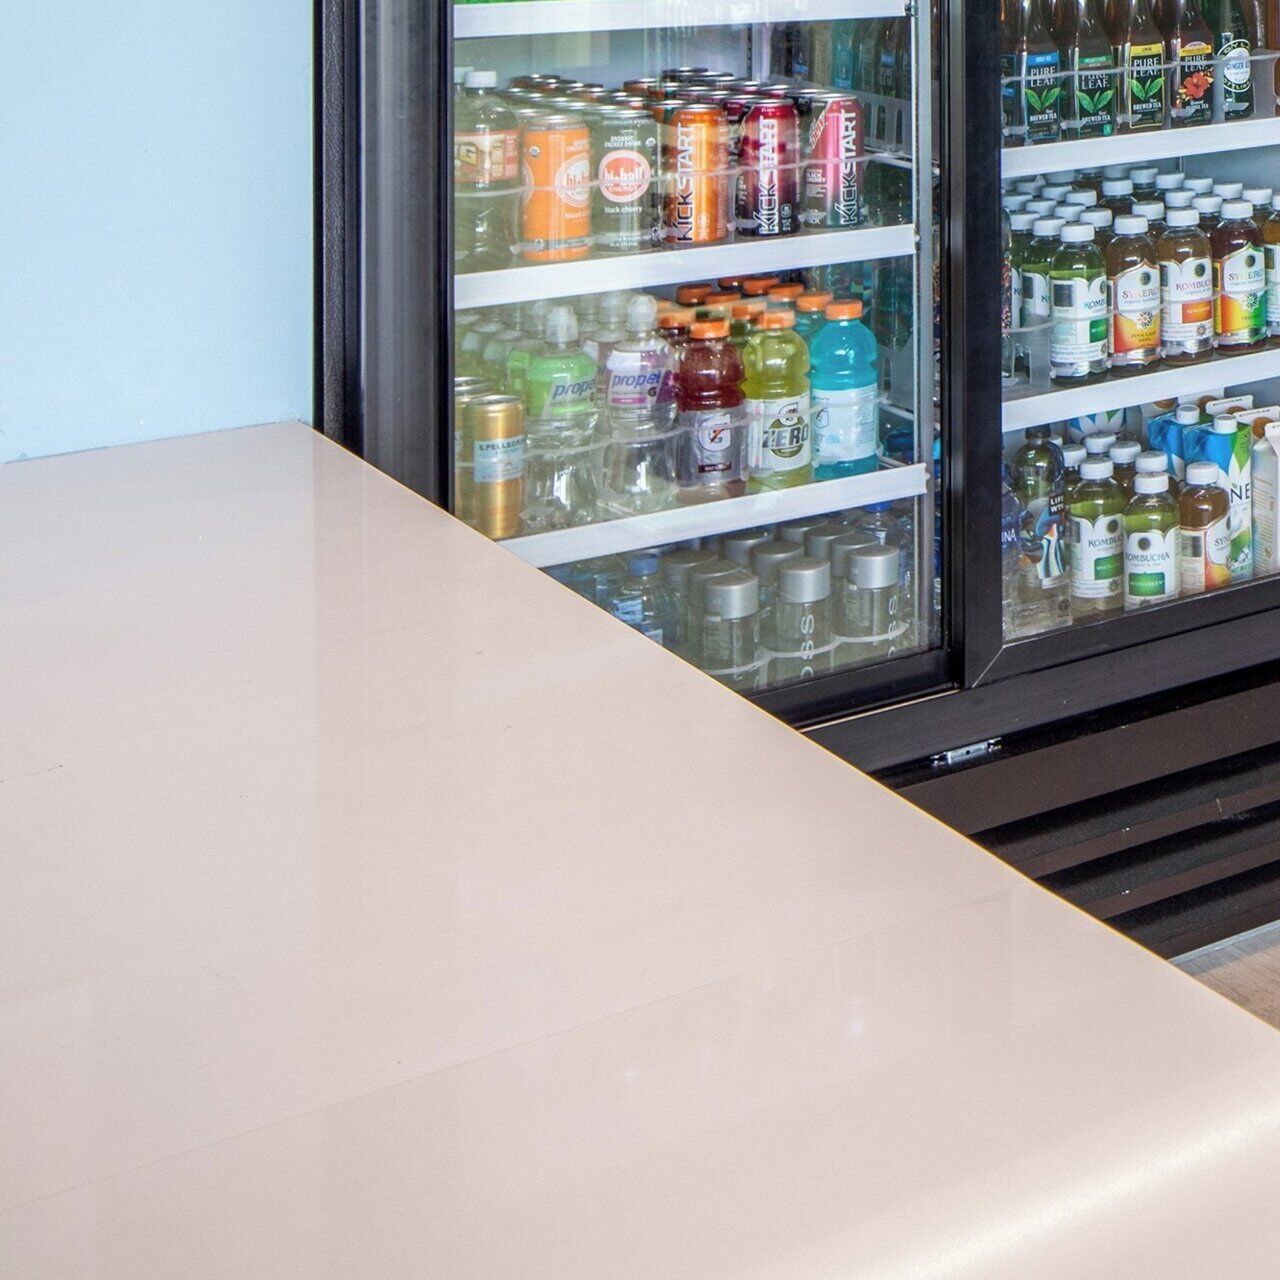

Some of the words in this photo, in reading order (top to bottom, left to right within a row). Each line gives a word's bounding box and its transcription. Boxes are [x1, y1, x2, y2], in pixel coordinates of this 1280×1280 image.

[1134, 57, 1159, 67] PURE
[1184, 55, 1206, 63] PURE
[1134, 69, 1160, 78] LEAF
[1030, 77, 1056, 88] LEAF
[1081, 79, 1110, 90] LEAF
[835, 109, 856, 225] KICKSTART
[753, 116, 779, 234] KICKSTART
[671, 122, 694, 242] KICKSTART
[621, 206, 643, 214] cherry
[613, 372, 661, 388] propel
[762, 423, 809, 448] ZERO
[1125, 552, 1170, 561] KOMBUCHA
